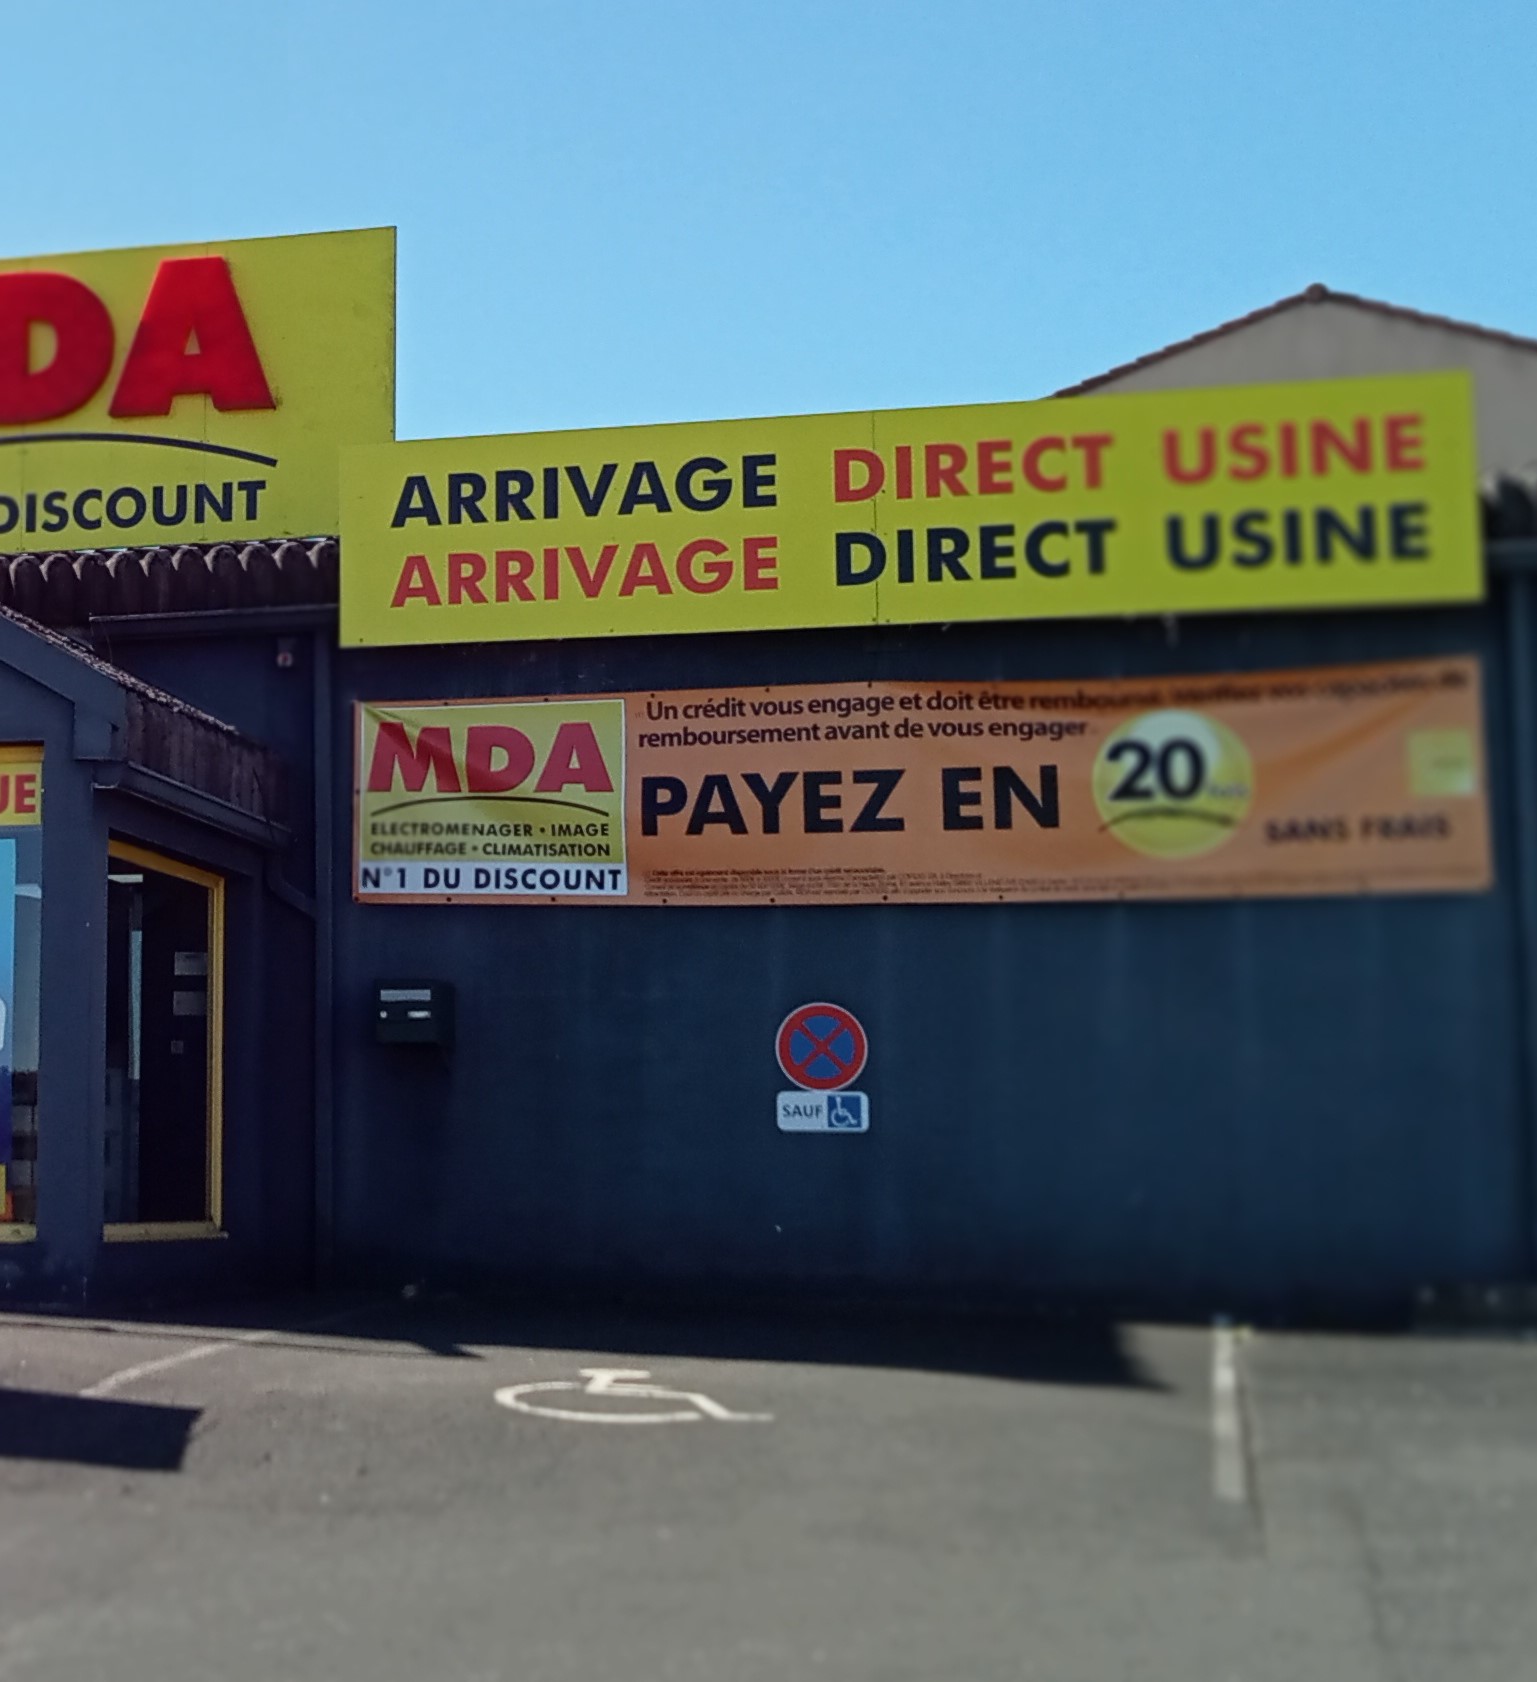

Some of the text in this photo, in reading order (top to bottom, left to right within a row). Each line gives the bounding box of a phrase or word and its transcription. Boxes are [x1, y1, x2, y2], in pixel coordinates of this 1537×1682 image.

[390, 413, 1426, 528] ARRIVAGE DIRECT USINE
[390, 502, 1431, 608] ARRIVAGE DIRECT USINE
[646, 701, 678, 720] Un
[682, 697, 746, 720] crédit
[750, 699, 804, 717] vous
[808, 695, 894, 722] engage
[899, 692, 923, 711] et
[926, 691, 974, 710] doit
[978, 693, 1025, 710] être
[638, 717, 1088, 747] remboursement avant de vous engager
[368, 721, 614, 793] MDA
[1106, 738, 1205, 801] 20
[640, 764, 1060, 836] PAYEZ EN
[371, 822, 609, 837] ELECTROMENAGER IMAGE
[371, 842, 611, 857] CHAUFFAGE CLIMATISATION
[362, 867, 407, 888] N°1
[423, 868, 461, 888] DU
[474, 868, 622, 890] DISCOUNT
[782, 1104, 823, 1118] SAUF
